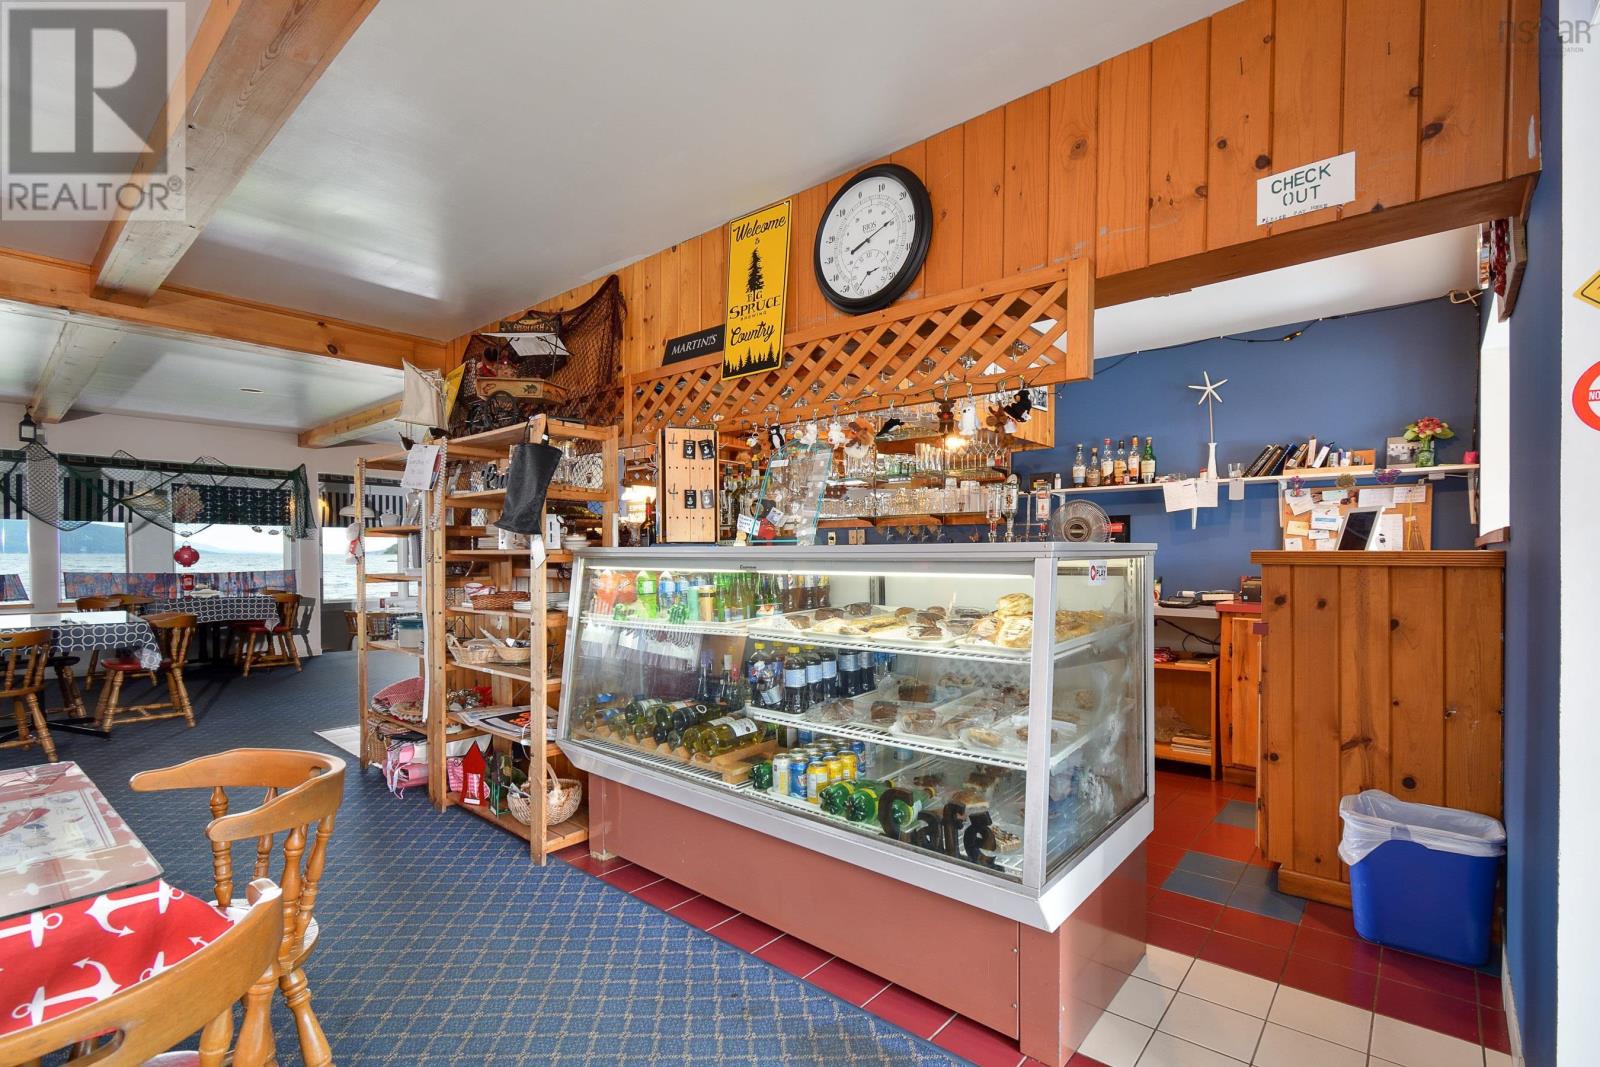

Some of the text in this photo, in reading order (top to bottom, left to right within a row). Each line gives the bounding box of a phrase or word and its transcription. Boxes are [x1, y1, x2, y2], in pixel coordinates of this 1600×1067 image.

[1271, 162, 1332, 195] CHECK
[1282, 184, 1321, 207] OUT
[733, 216, 786, 242] Welcome
[729, 295, 781, 320] SPRUCE
[730, 321, 776, 346] Country
